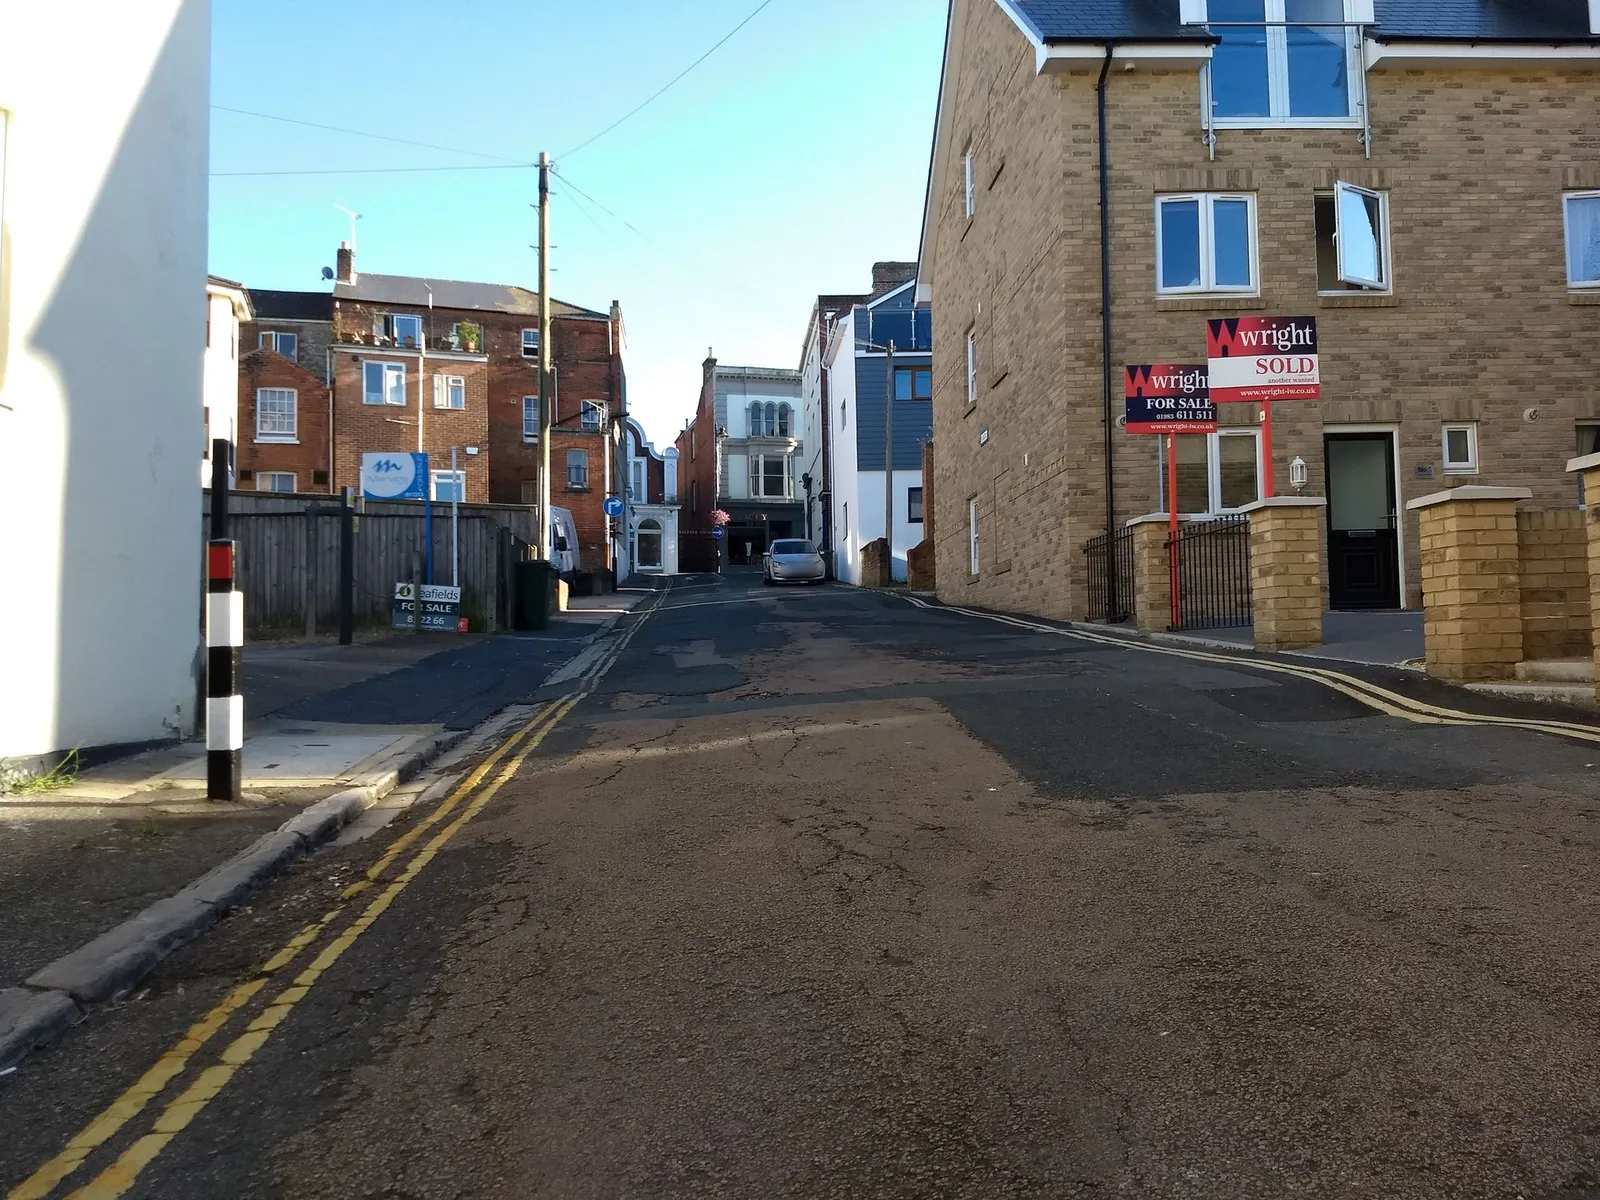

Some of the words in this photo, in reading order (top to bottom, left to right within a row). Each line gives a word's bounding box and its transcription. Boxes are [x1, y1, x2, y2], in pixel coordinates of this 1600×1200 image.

[1238, 322, 1313, 351] wright
[1255, 357, 1314, 375] SOLD
[1292, 376, 1315, 384] wanted
[1240, 387, 1316, 397] www.wright-iw.co.uk
[1146, 399, 1177, 410] FOR
[1178, 398, 1214, 410] SALE
[1176, 411, 1195, 420] 611
[1196, 411, 1213, 420] 511
[420, 588, 459, 600] eafields
[425, 603, 452, 613] SALE
[433, 617, 444, 625] 66
